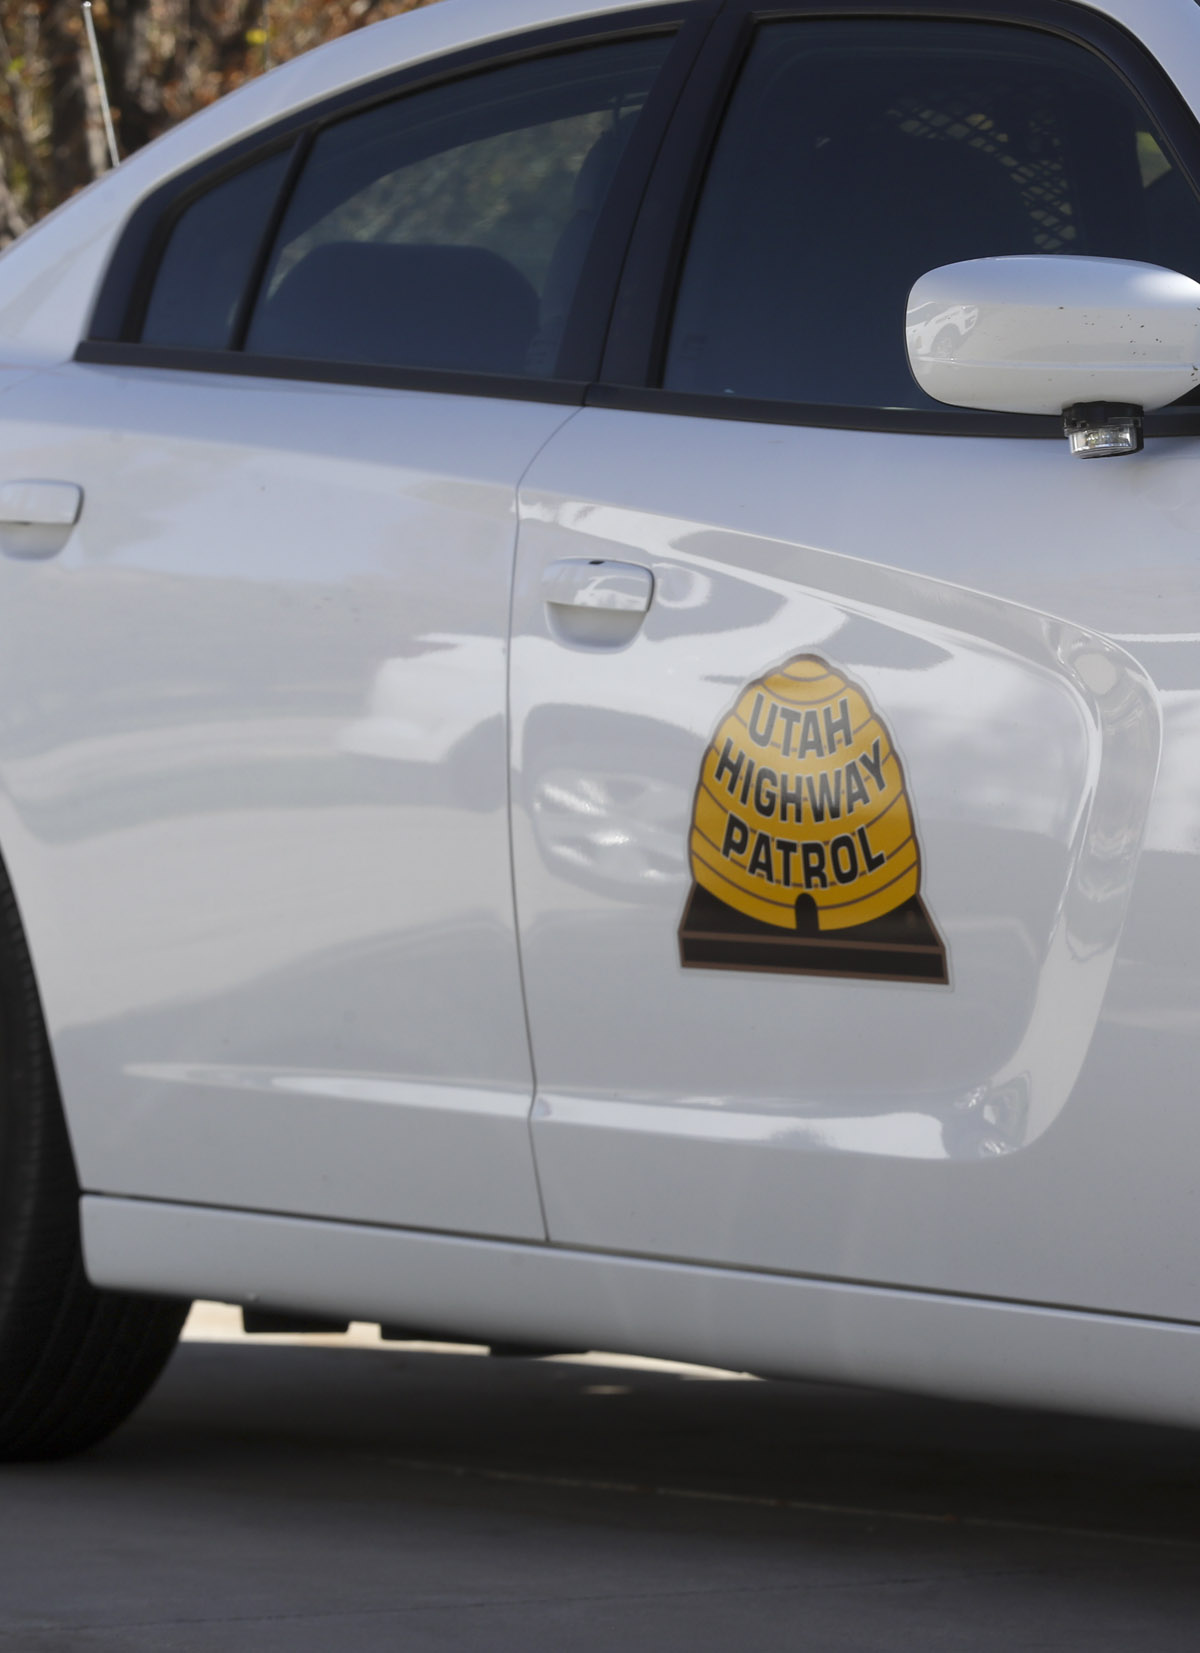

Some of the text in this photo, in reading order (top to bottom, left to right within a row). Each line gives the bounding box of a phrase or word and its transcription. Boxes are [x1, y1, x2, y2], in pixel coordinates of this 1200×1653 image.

[749, 692, 853, 760] UTAH
[714, 736, 887, 824] HIGHWAY
[721, 812, 886, 890] PATROL
